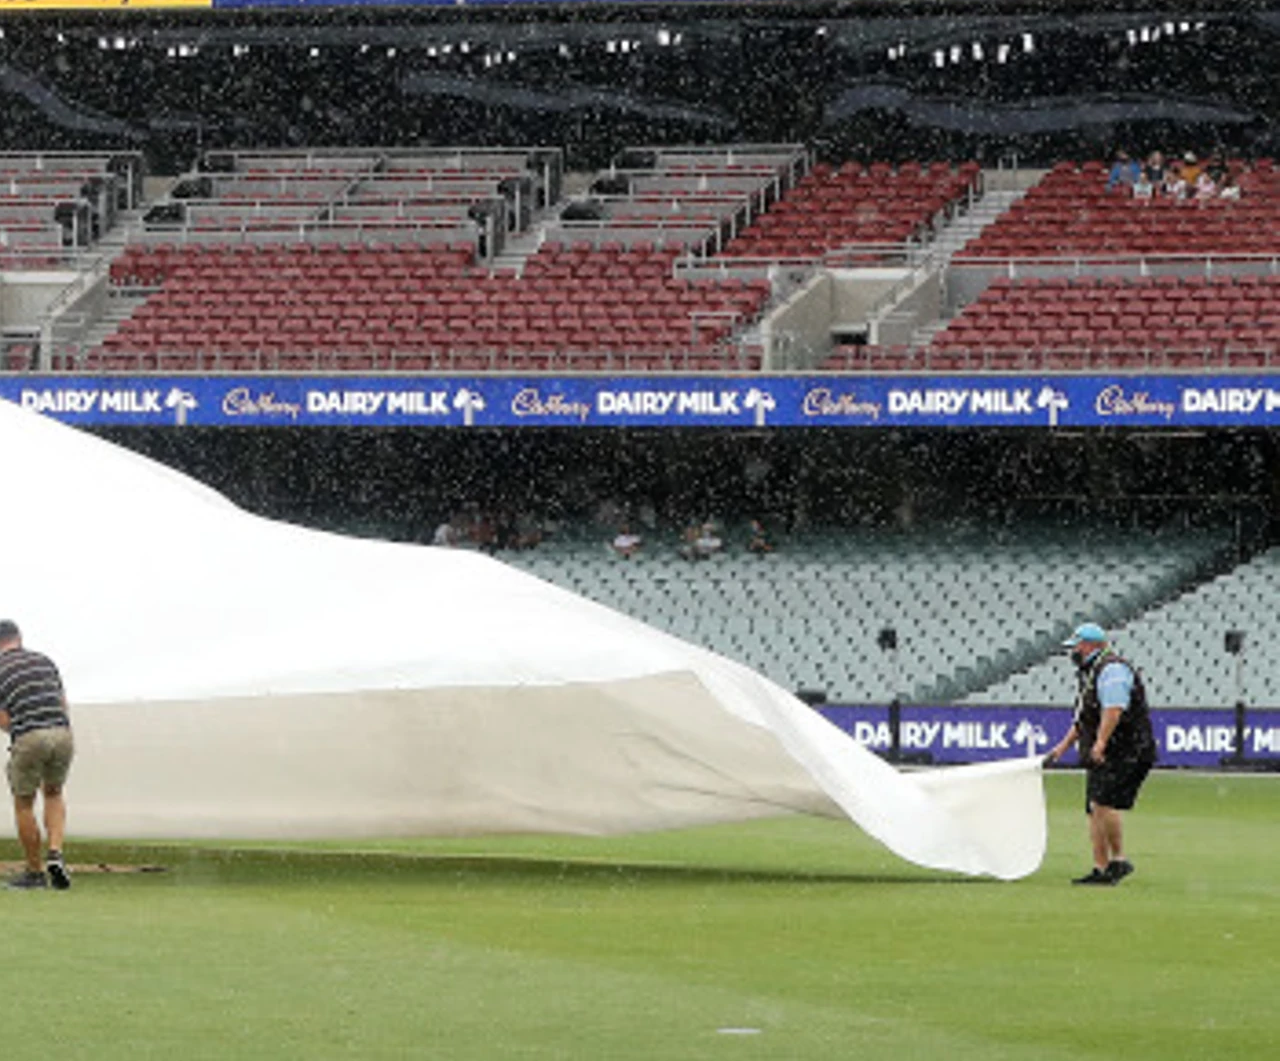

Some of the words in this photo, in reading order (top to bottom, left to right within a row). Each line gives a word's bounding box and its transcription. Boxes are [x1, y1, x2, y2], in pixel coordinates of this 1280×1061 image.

[21, 389, 99, 413] DAIRY
[99, 389, 161, 413] MILK
[222, 388, 301, 420] Cadbury
[306, 390, 385, 414] DAIRY
[386, 390, 449, 415] MILK
[512, 388, 591, 422] Cadbury
[597, 390, 677, 415] DAIRY
[676, 390, 740, 415] MILK
[803, 388, 882, 420] Cadbury
[888, 389, 969, 414] DAIRY
[970, 389, 1033, 414] MILK
[1096, 384, 1175, 421] Cadbury
[1183, 388, 1262, 413] DAIRY
[854, 721, 940, 749] DAIRY
[943, 721, 1010, 749] MILK
